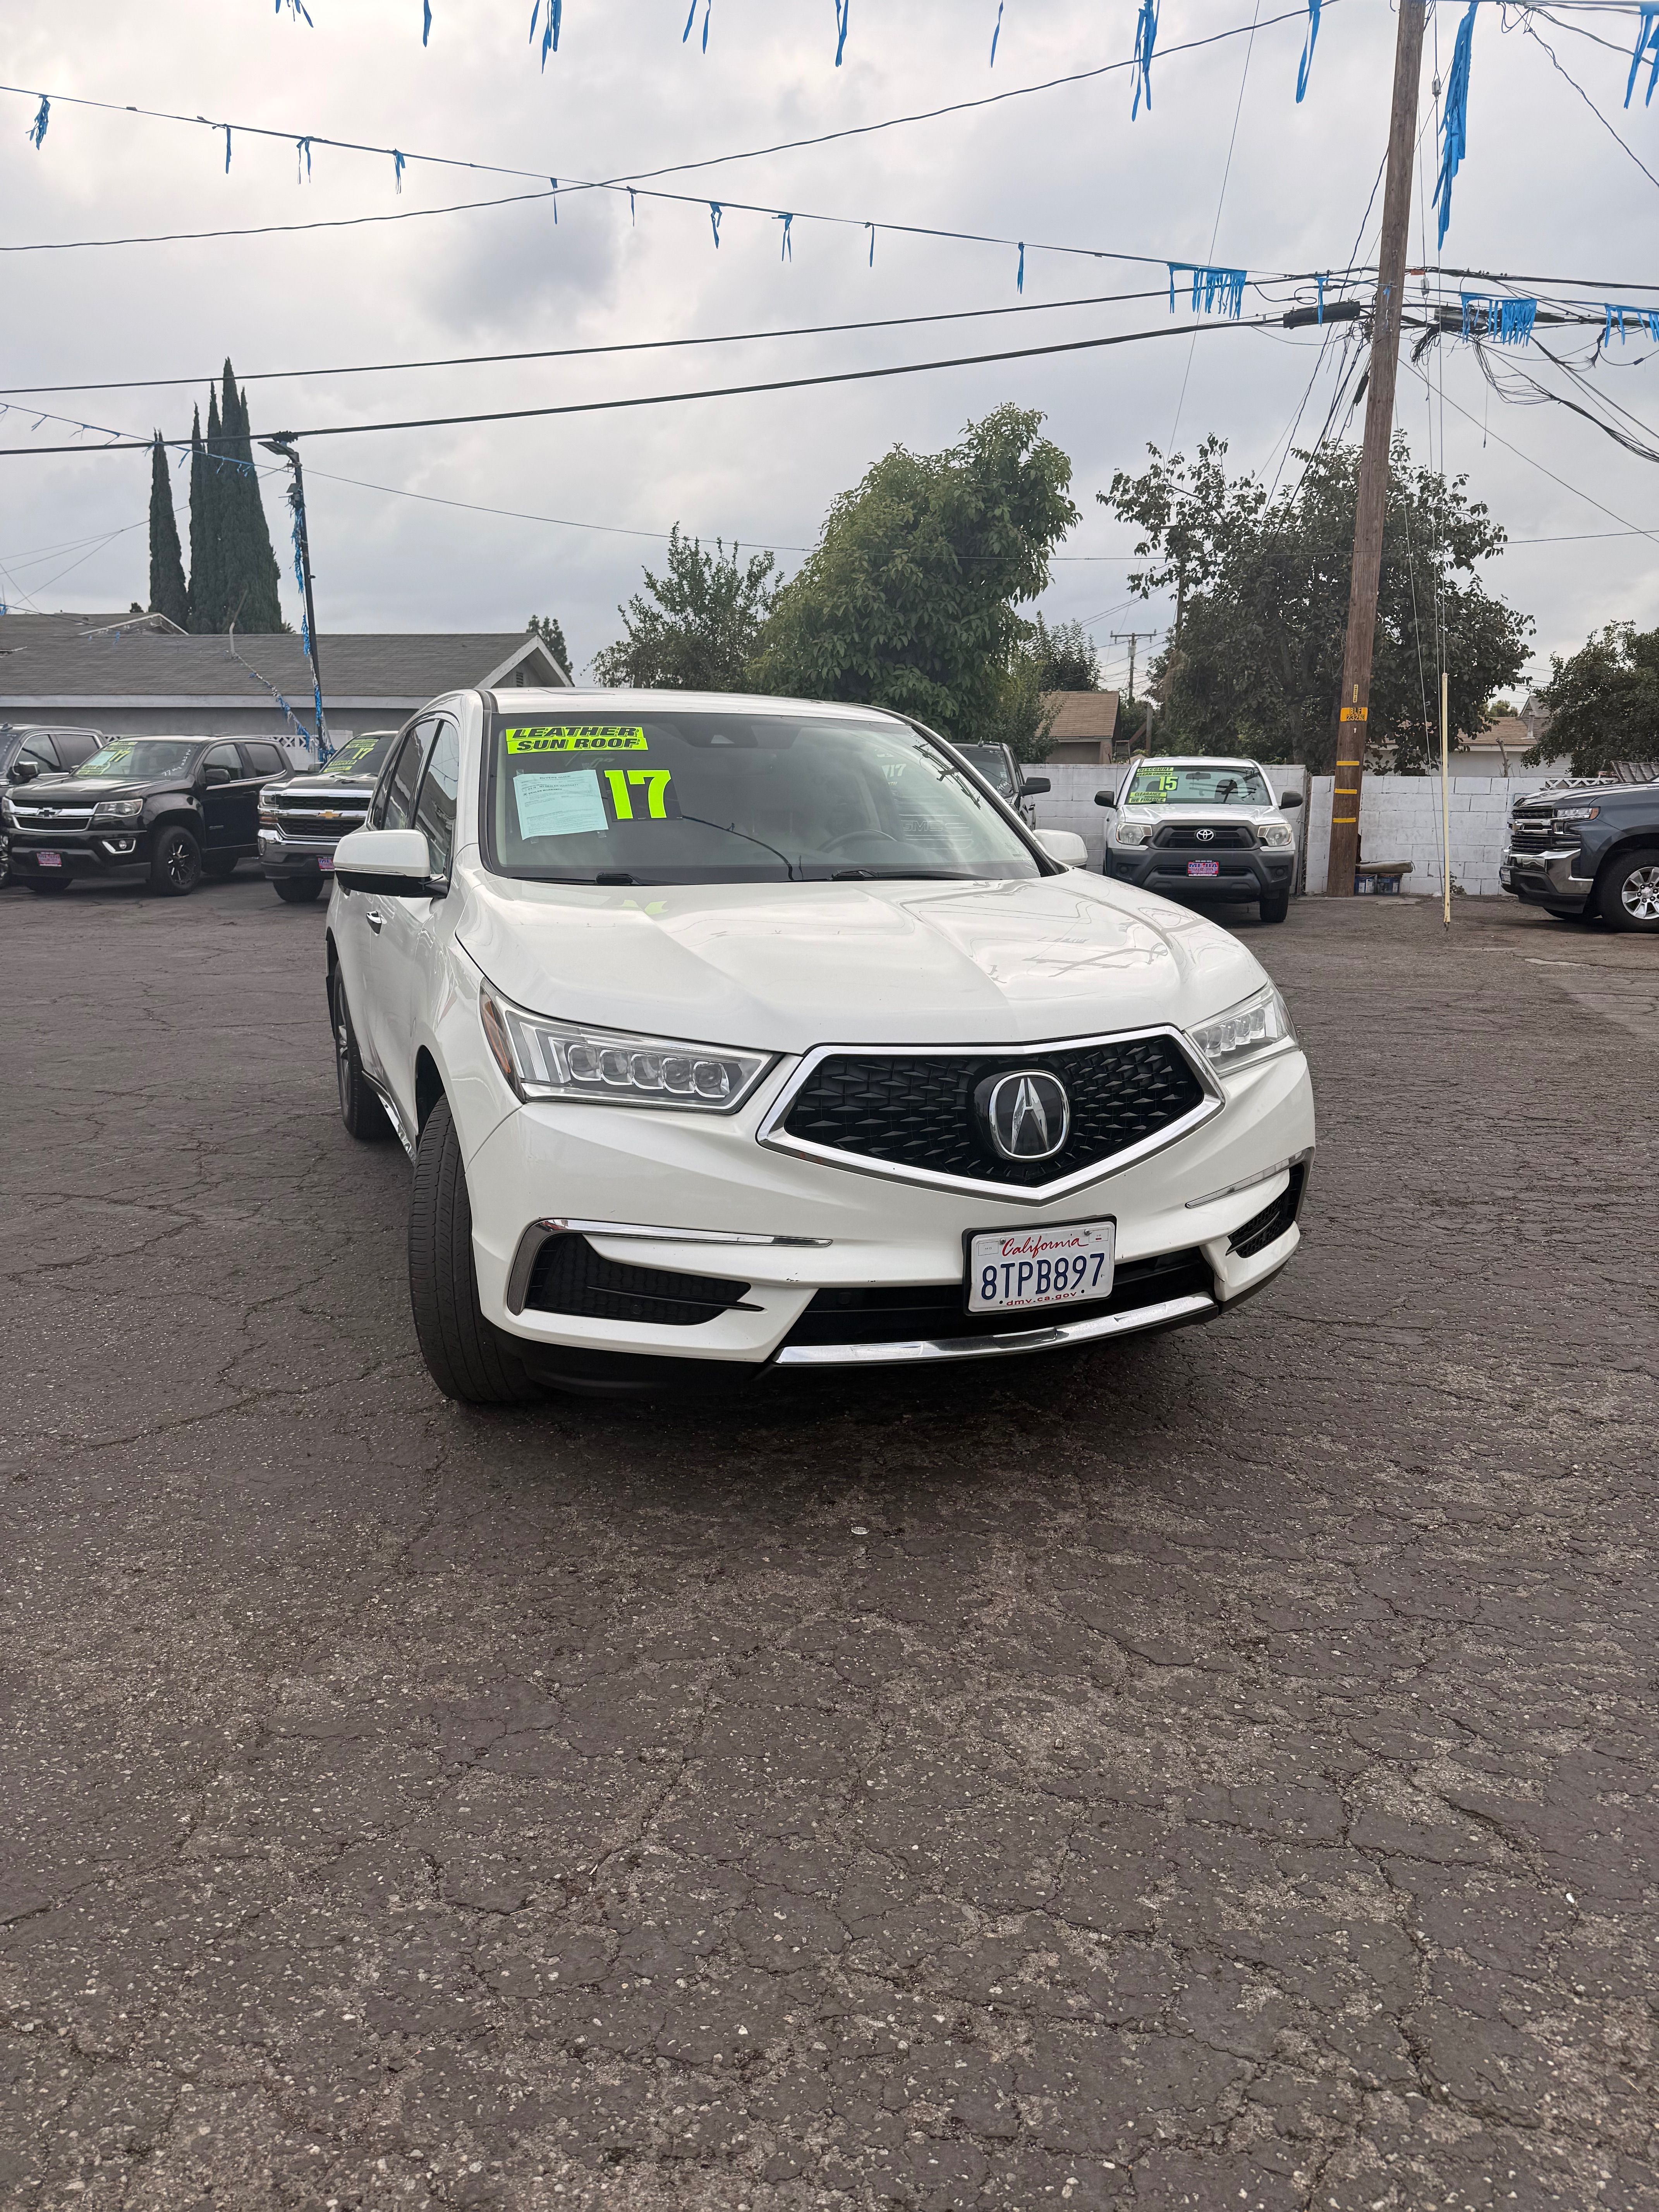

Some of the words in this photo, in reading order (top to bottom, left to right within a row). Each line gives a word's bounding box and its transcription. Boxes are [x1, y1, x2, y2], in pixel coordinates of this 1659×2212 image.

[512, 727, 639, 739] LEATHER
[517, 739, 569, 751] SUN
[574, 738, 640, 749] ROOF
[108, 750, 131, 762] 17
[352, 747, 374, 759] 17
[1159, 776, 1178, 790] 15
[604, 770, 672, 819] 17
[1002, 1234, 1089, 1258] California
[981, 1253, 1104, 1300] 8TPB897
[1006, 1291, 1077, 1306] dmv.ca.gov
